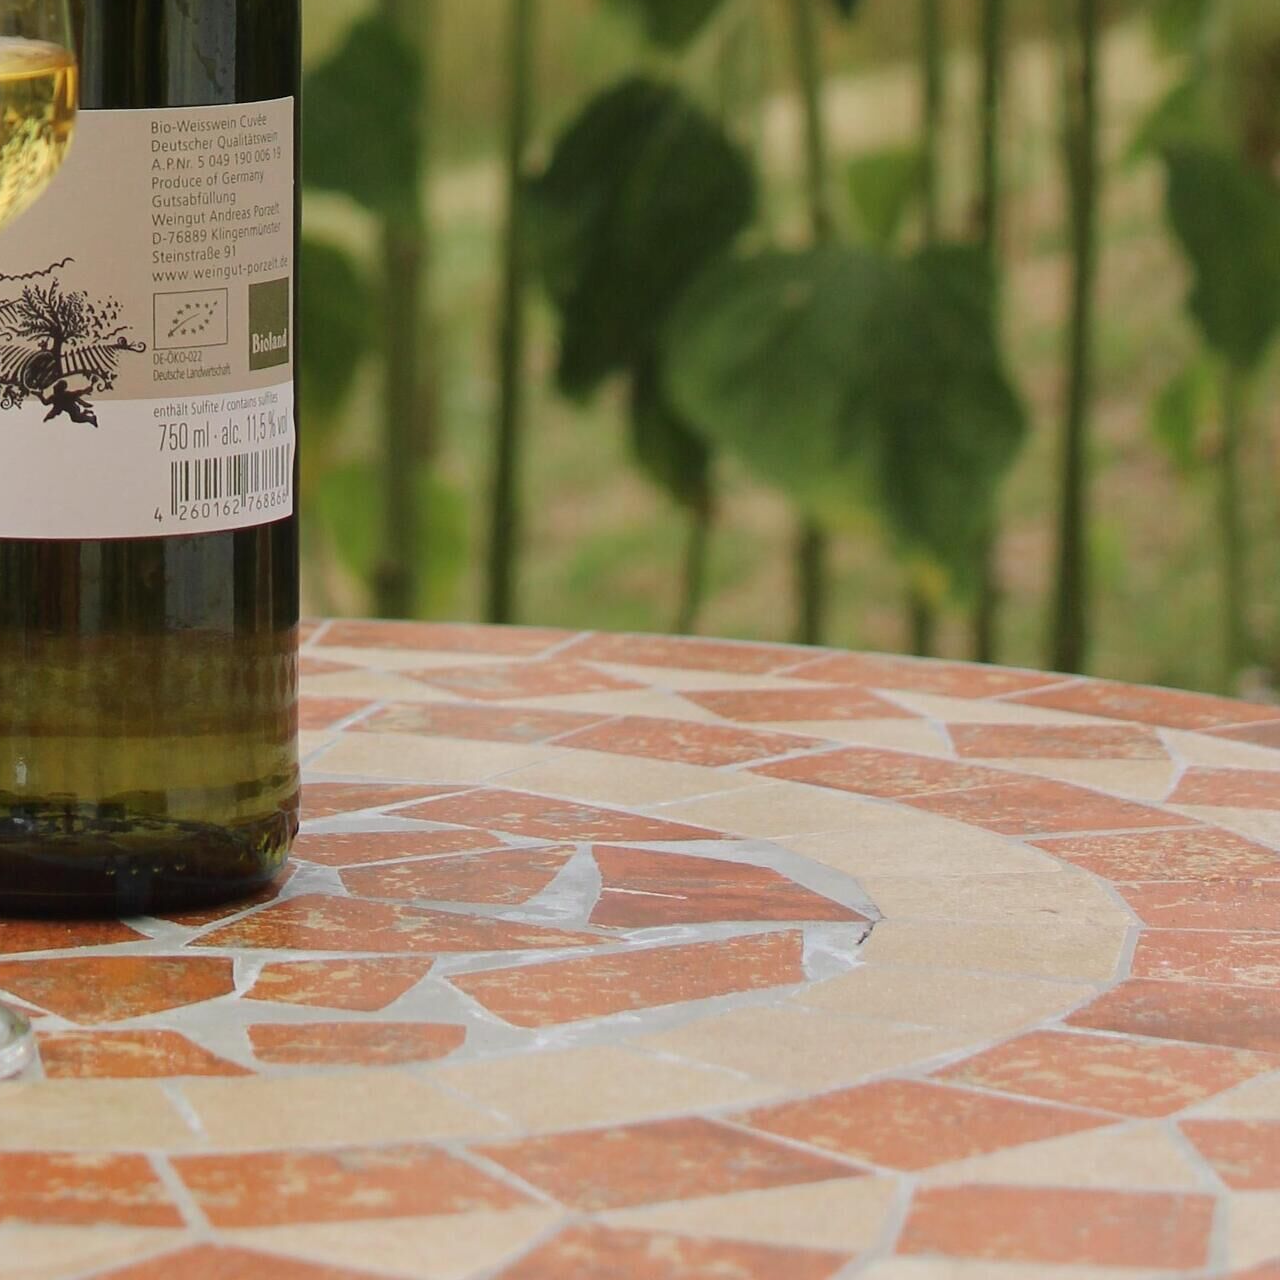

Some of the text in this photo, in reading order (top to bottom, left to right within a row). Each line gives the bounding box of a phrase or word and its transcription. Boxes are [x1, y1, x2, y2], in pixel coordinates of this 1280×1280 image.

[151, 113, 268, 134] Bio-Weisswein Cuvée
[151, 131, 279, 153] Deutscher Qualitätswein
[198, 155, 205, 169] 5
[208, 153, 230, 167] 049
[234, 151, 252, 165] 190
[254, 148, 271, 163] 006
[151, 170, 264, 190] Produce of Germany
[151, 191, 237, 208] Gutsabfüllung
[151, 202, 280, 228] Weingut Andreas Porzelt
[152, 222, 281, 245] D-76889 Klingenmünster
[152, 245, 236, 264] Steinstraße 91
[252, 328, 287, 354] Bioland
[153, 350, 202, 366] DE-ÖKO-022
[153, 363, 231, 381] Deutsche Landwirtschaft
[153, 402, 189, 418] enthält
[191, 399, 219, 416] Sulfite
[226, 395, 257, 412] contains
[158, 422, 189, 452] 750
[193, 421, 210, 449] ml
[221, 418, 242, 446] alc.
[154, 490, 290, 523] 4 260162 768866
